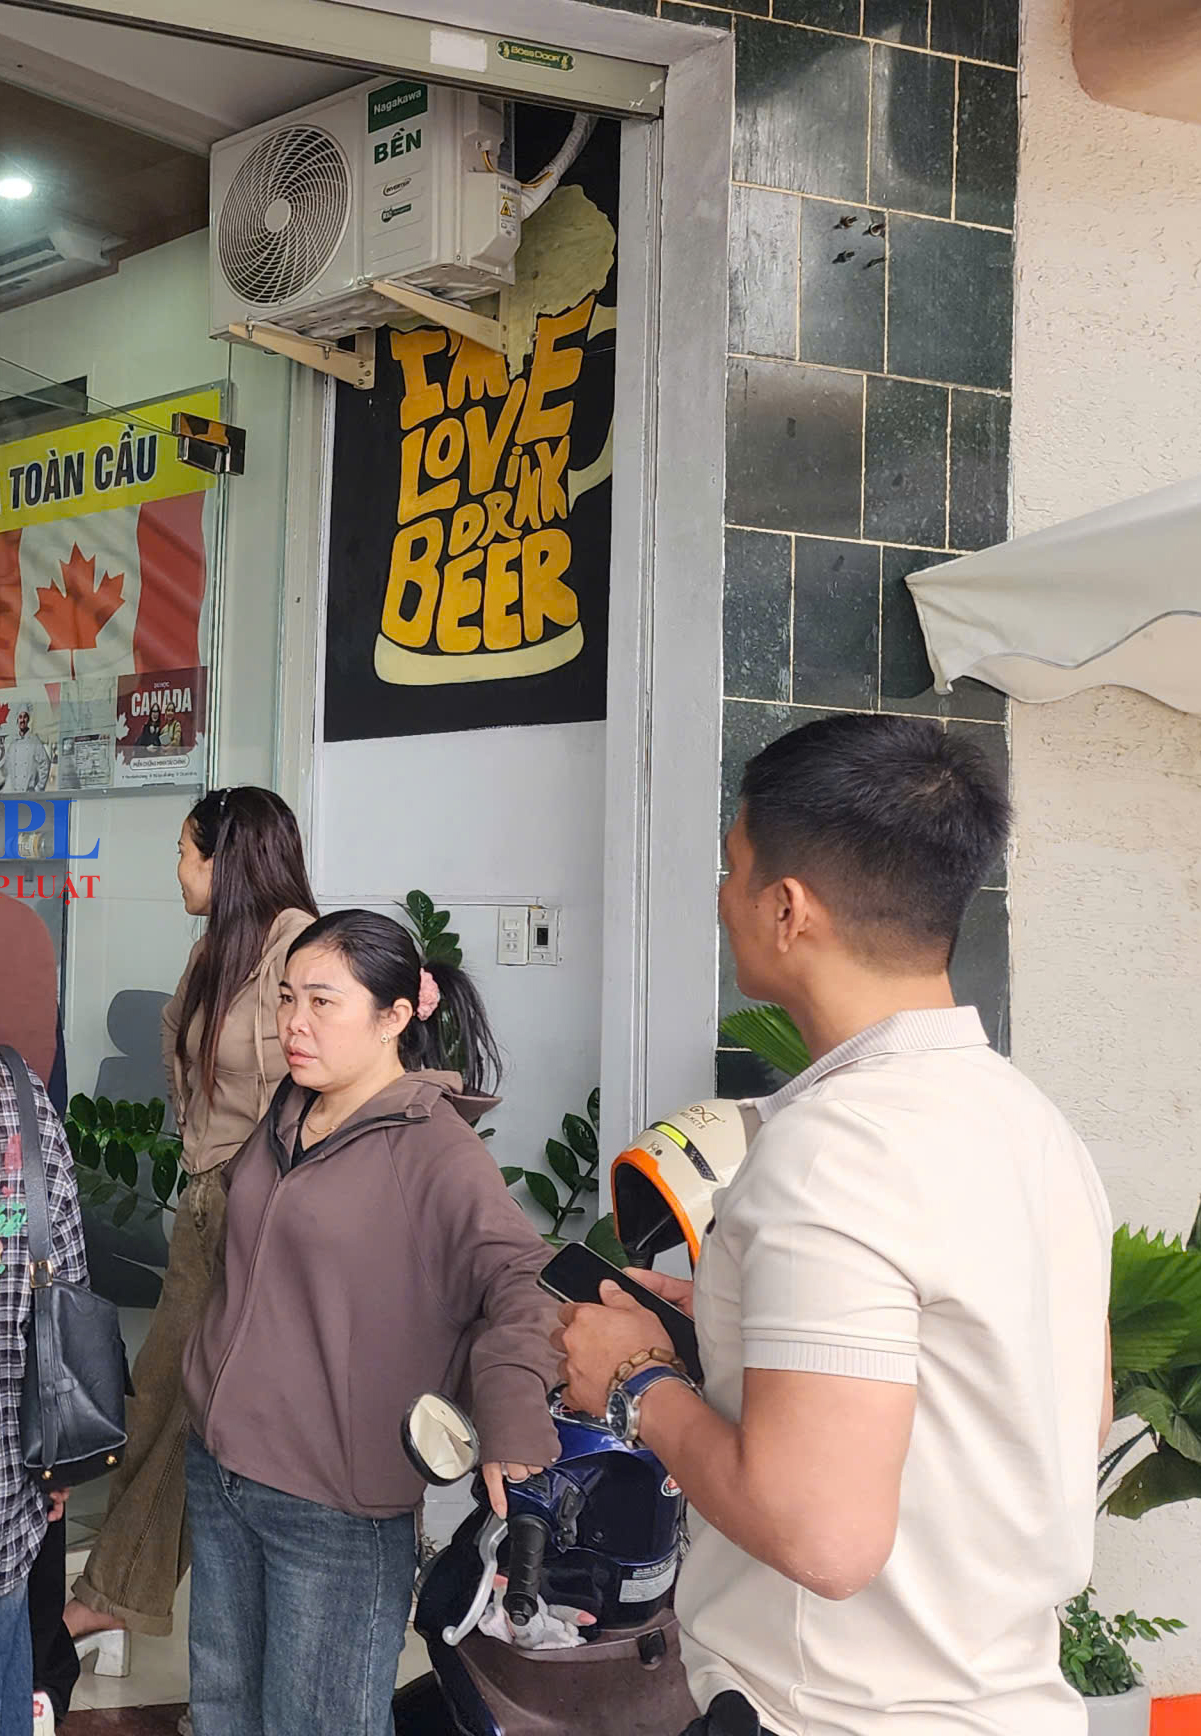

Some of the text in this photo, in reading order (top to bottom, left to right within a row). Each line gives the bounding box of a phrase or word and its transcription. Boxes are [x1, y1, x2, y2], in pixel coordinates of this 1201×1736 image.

[373, 89, 422, 115] Nagakawa
[374, 127, 422, 165] BỀN
[9, 450, 85, 510] TOÀN
[94, 424, 158, 491] CẦU
[381, 516, 579, 653] BEER
[131, 687, 193, 717] CANADA
